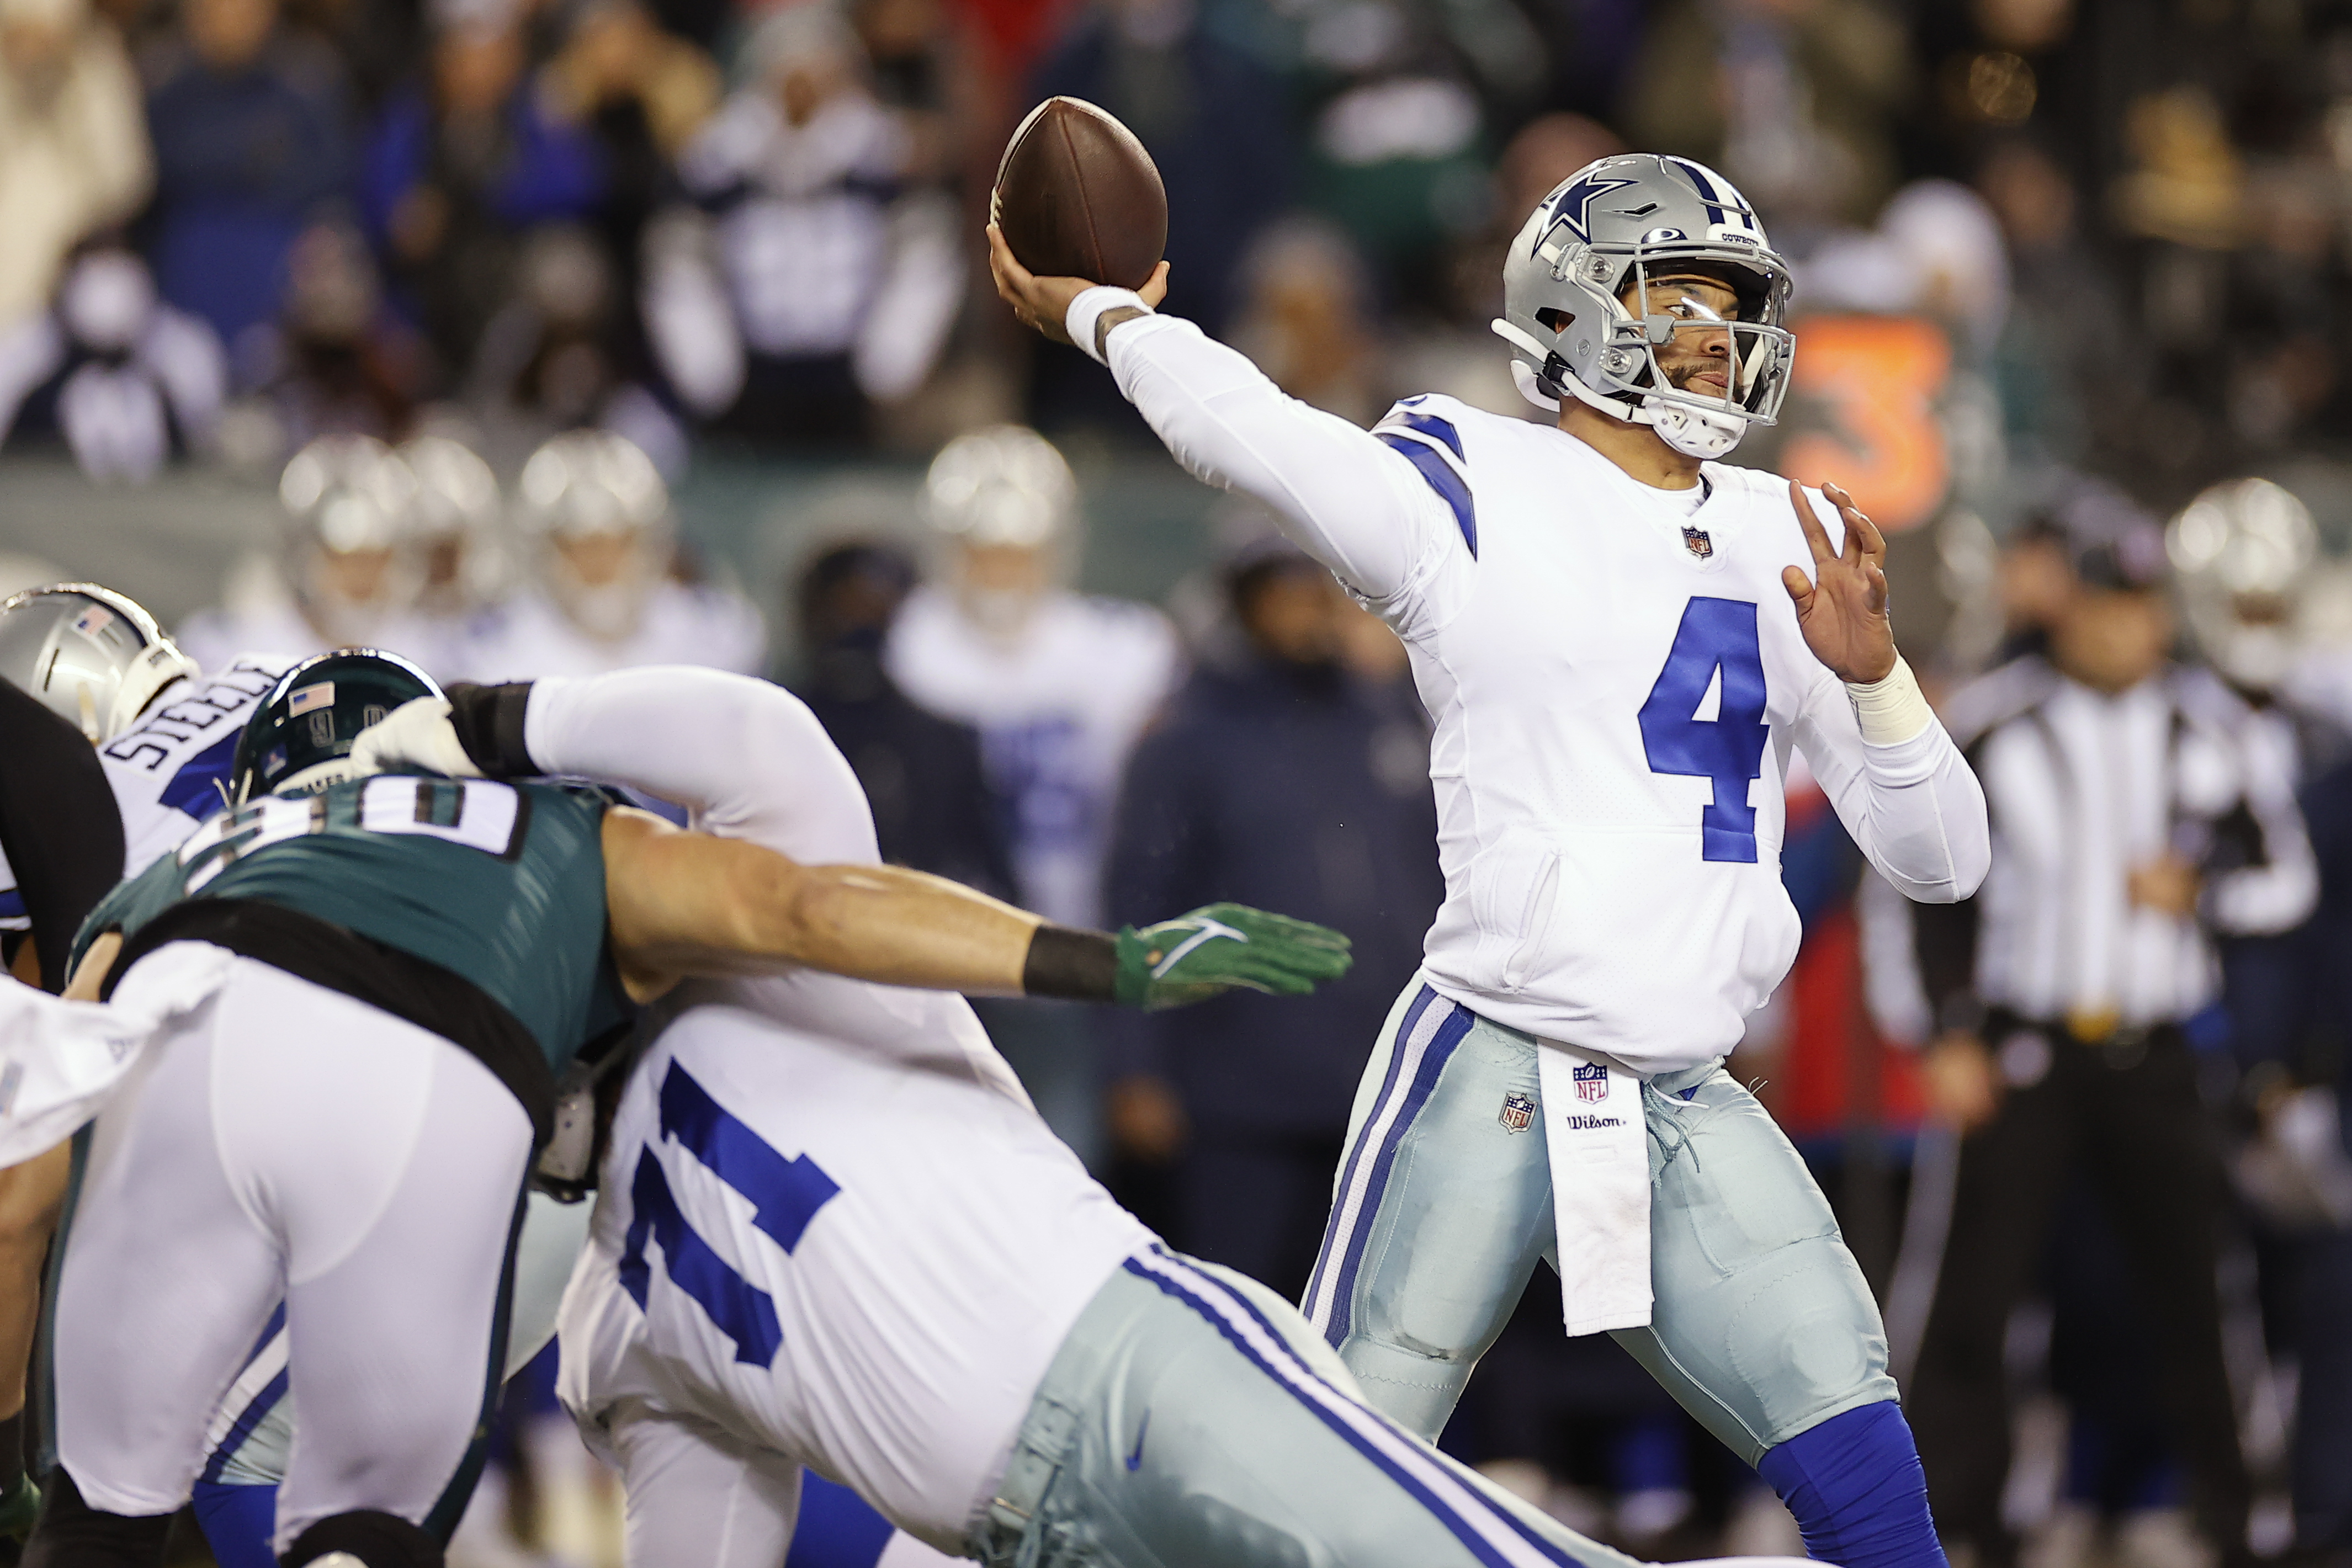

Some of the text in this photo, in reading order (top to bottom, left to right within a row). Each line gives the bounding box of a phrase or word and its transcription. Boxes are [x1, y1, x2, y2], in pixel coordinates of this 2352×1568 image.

[1690, 538, 1709, 552] NFL
[1637, 596, 1770, 863] 4
[178, 774, 531, 897] 90
[1576, 1081, 1605, 1101] NFL
[1505, 1108, 1526, 1126] NFL
[1567, 1115, 1621, 1129] Wilson
[618, 1054, 842, 1372] 71
